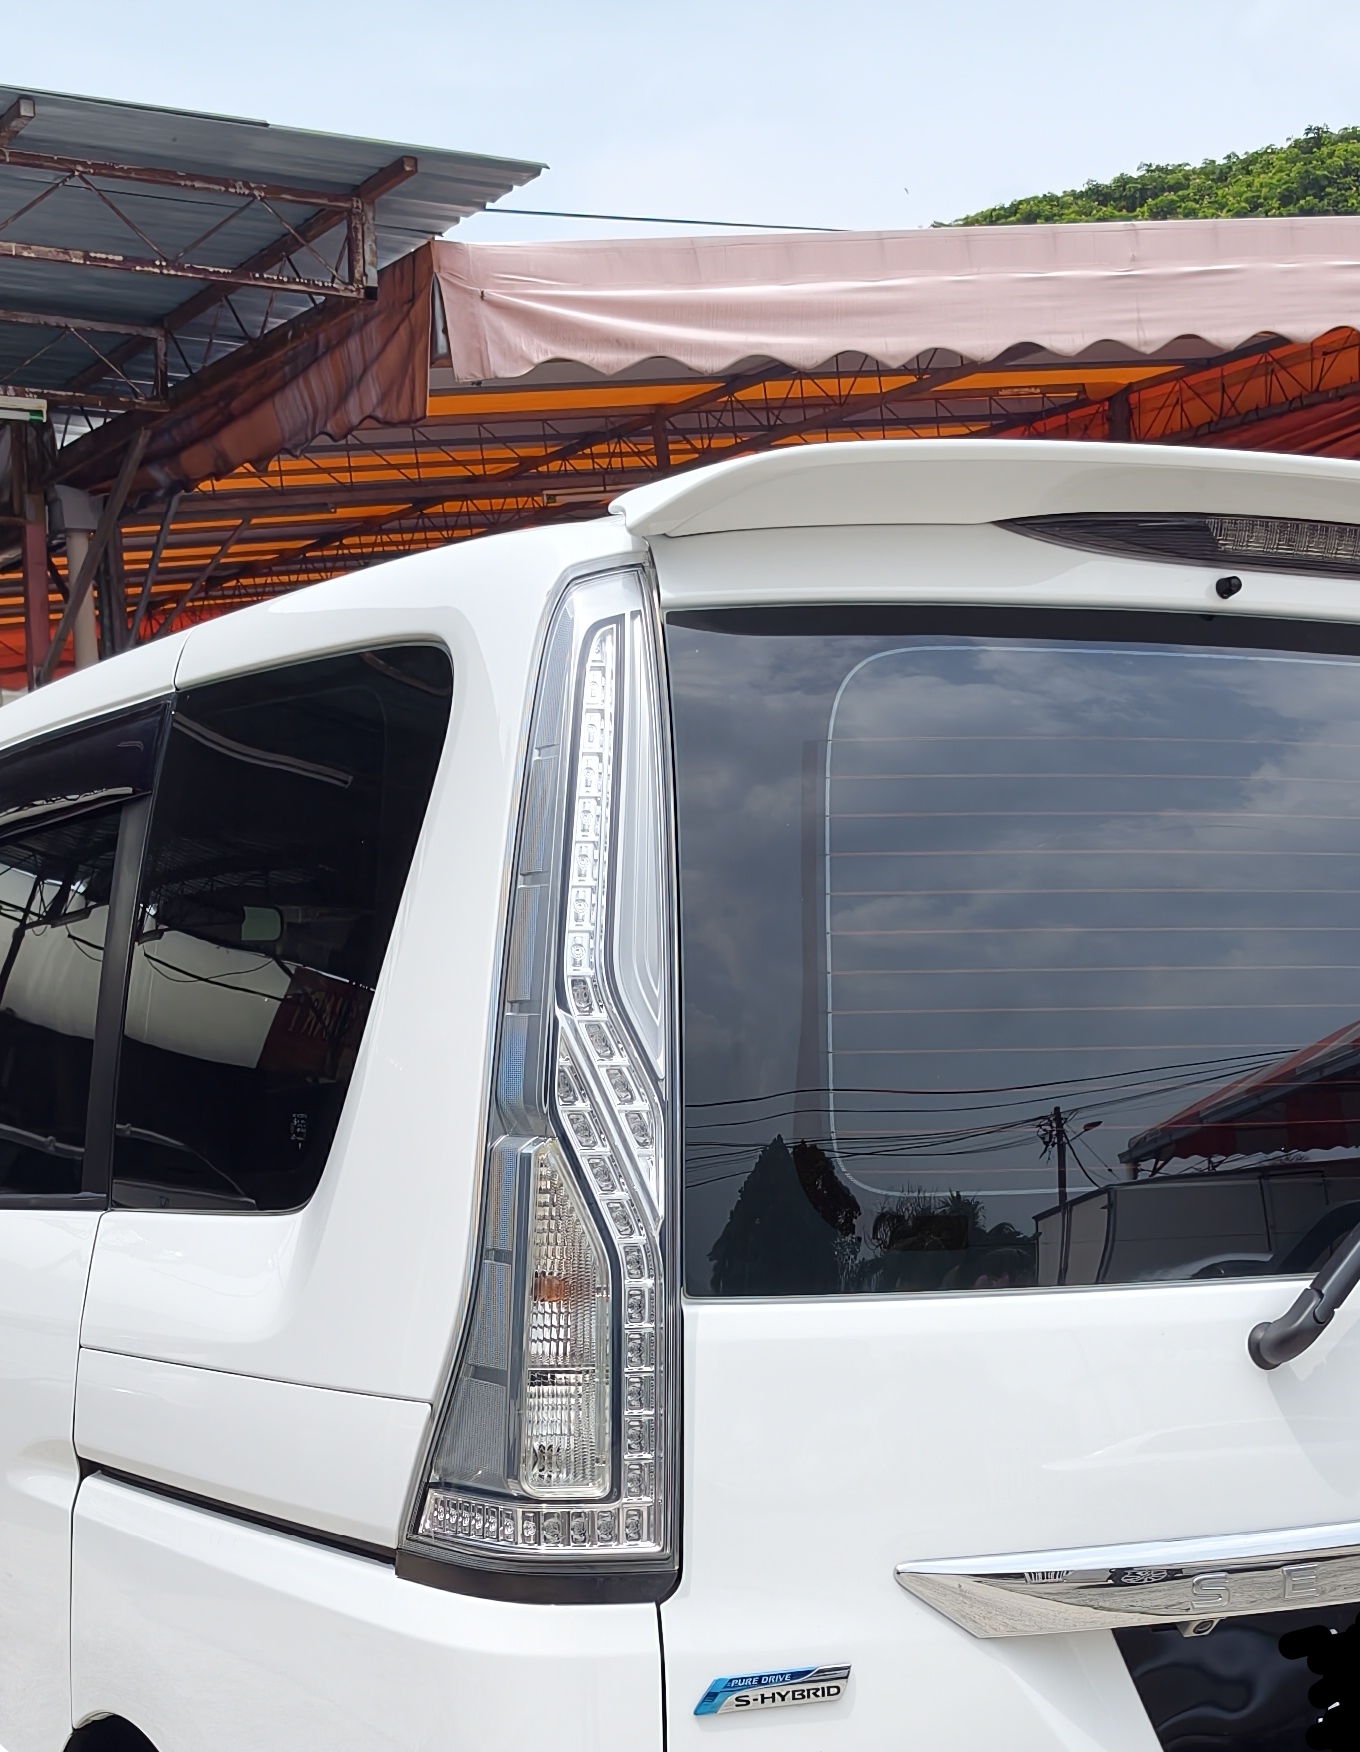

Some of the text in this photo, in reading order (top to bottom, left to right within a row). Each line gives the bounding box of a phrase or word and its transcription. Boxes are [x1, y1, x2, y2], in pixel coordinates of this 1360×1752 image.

[730, 1673, 792, 1688] PURE DRIVE
[734, 1685, 841, 1708] S-HYBRID
